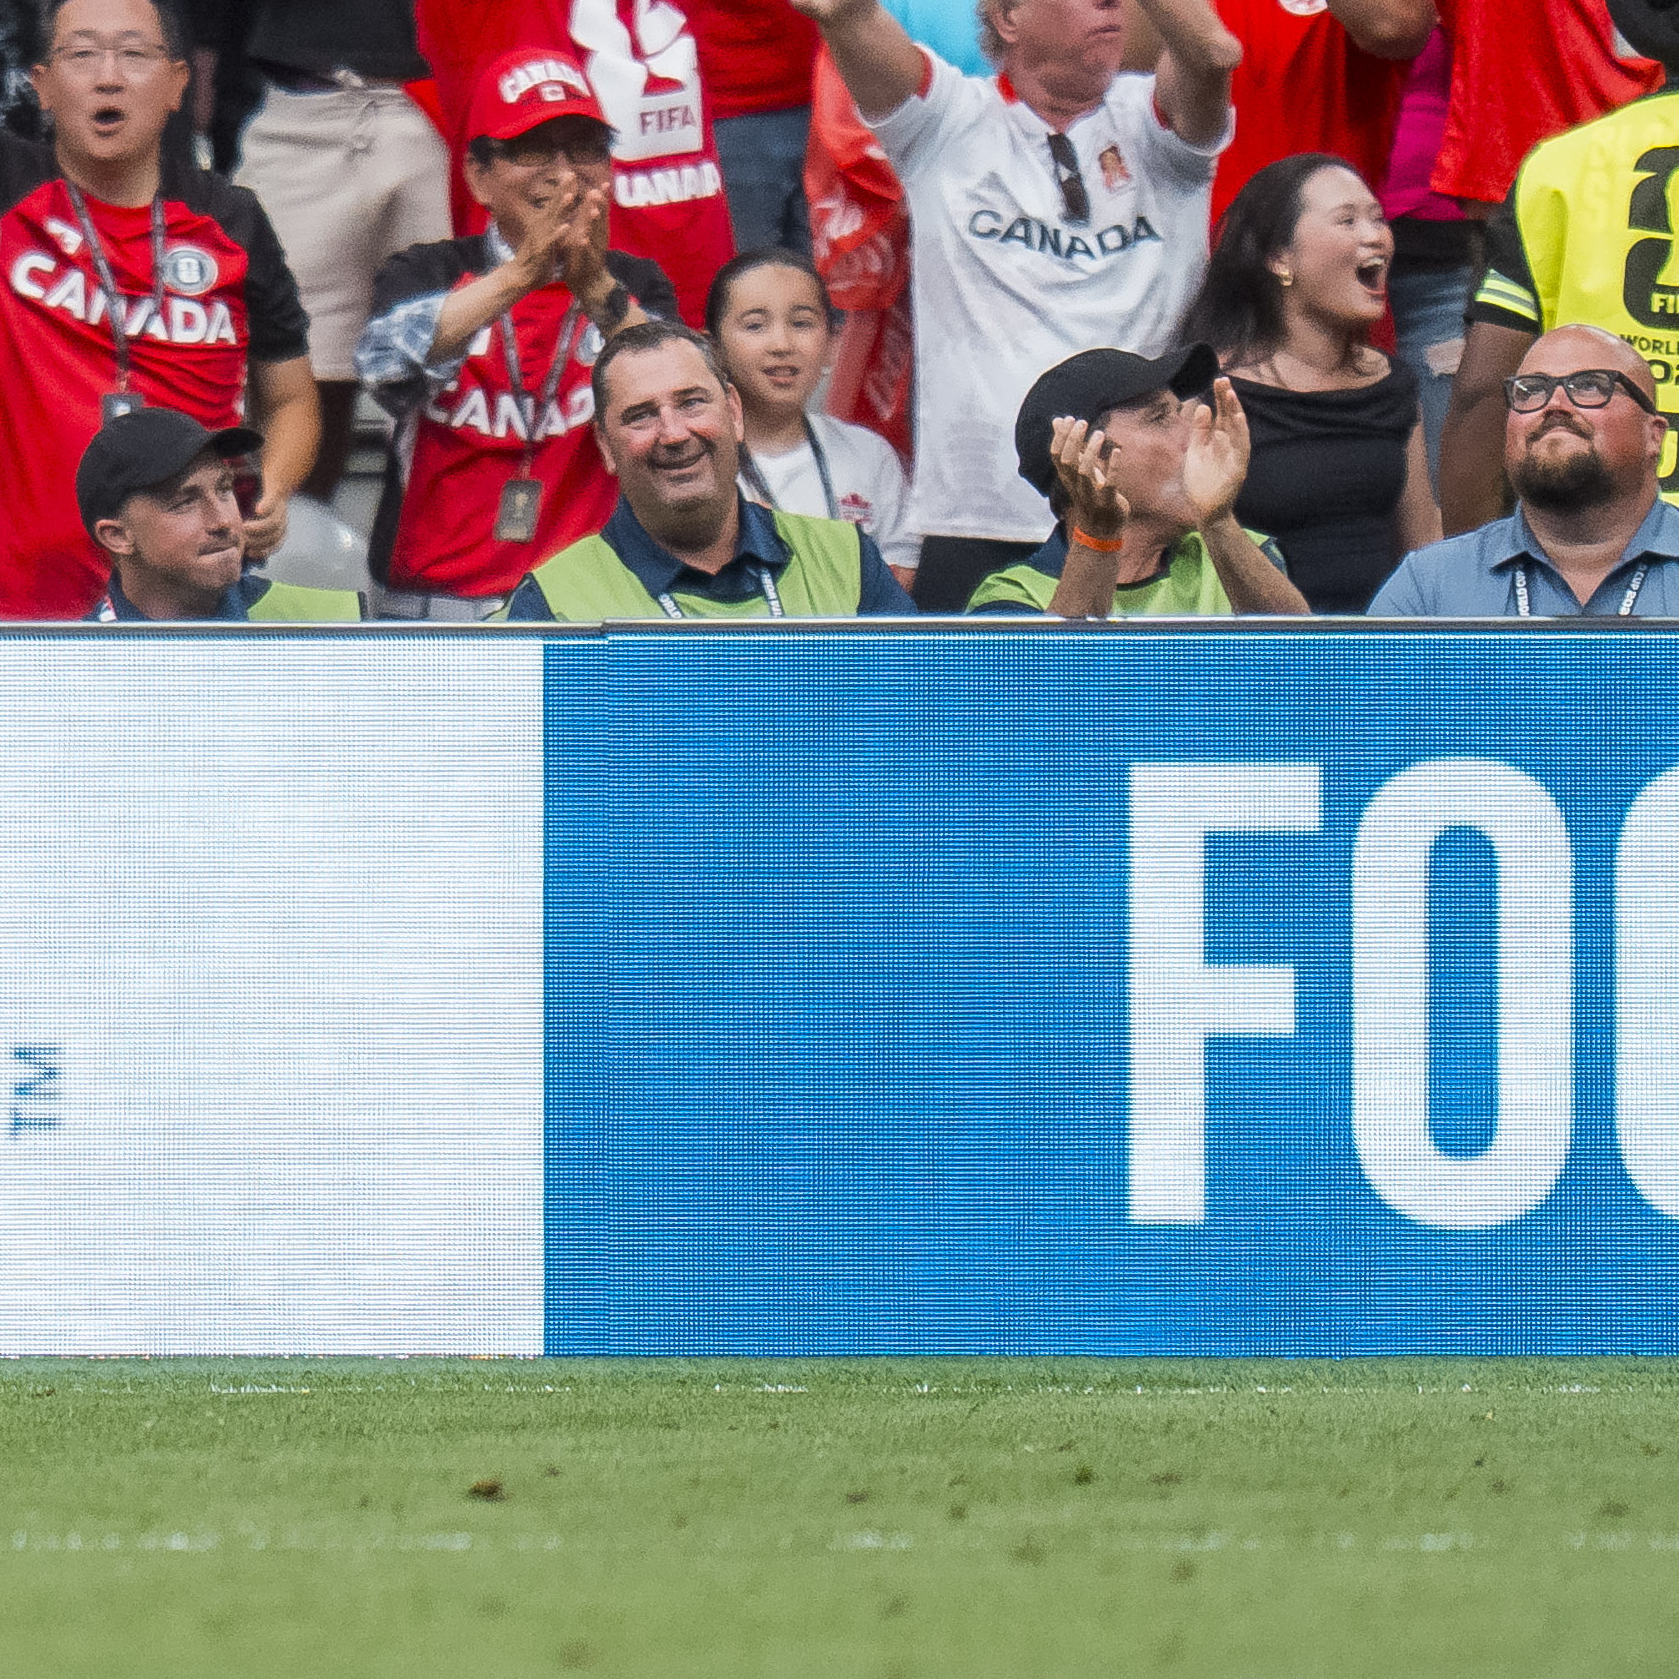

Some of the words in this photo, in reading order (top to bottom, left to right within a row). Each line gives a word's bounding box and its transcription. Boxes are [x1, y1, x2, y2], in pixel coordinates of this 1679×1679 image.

[639, 105, 696, 137] FIFA
[968, 207, 1163, 264] CANADA
[11, 250, 237, 348] CANADA
[1629, 570, 1645, 591] CUP
[1129, 758, 1679, 1230] FO
